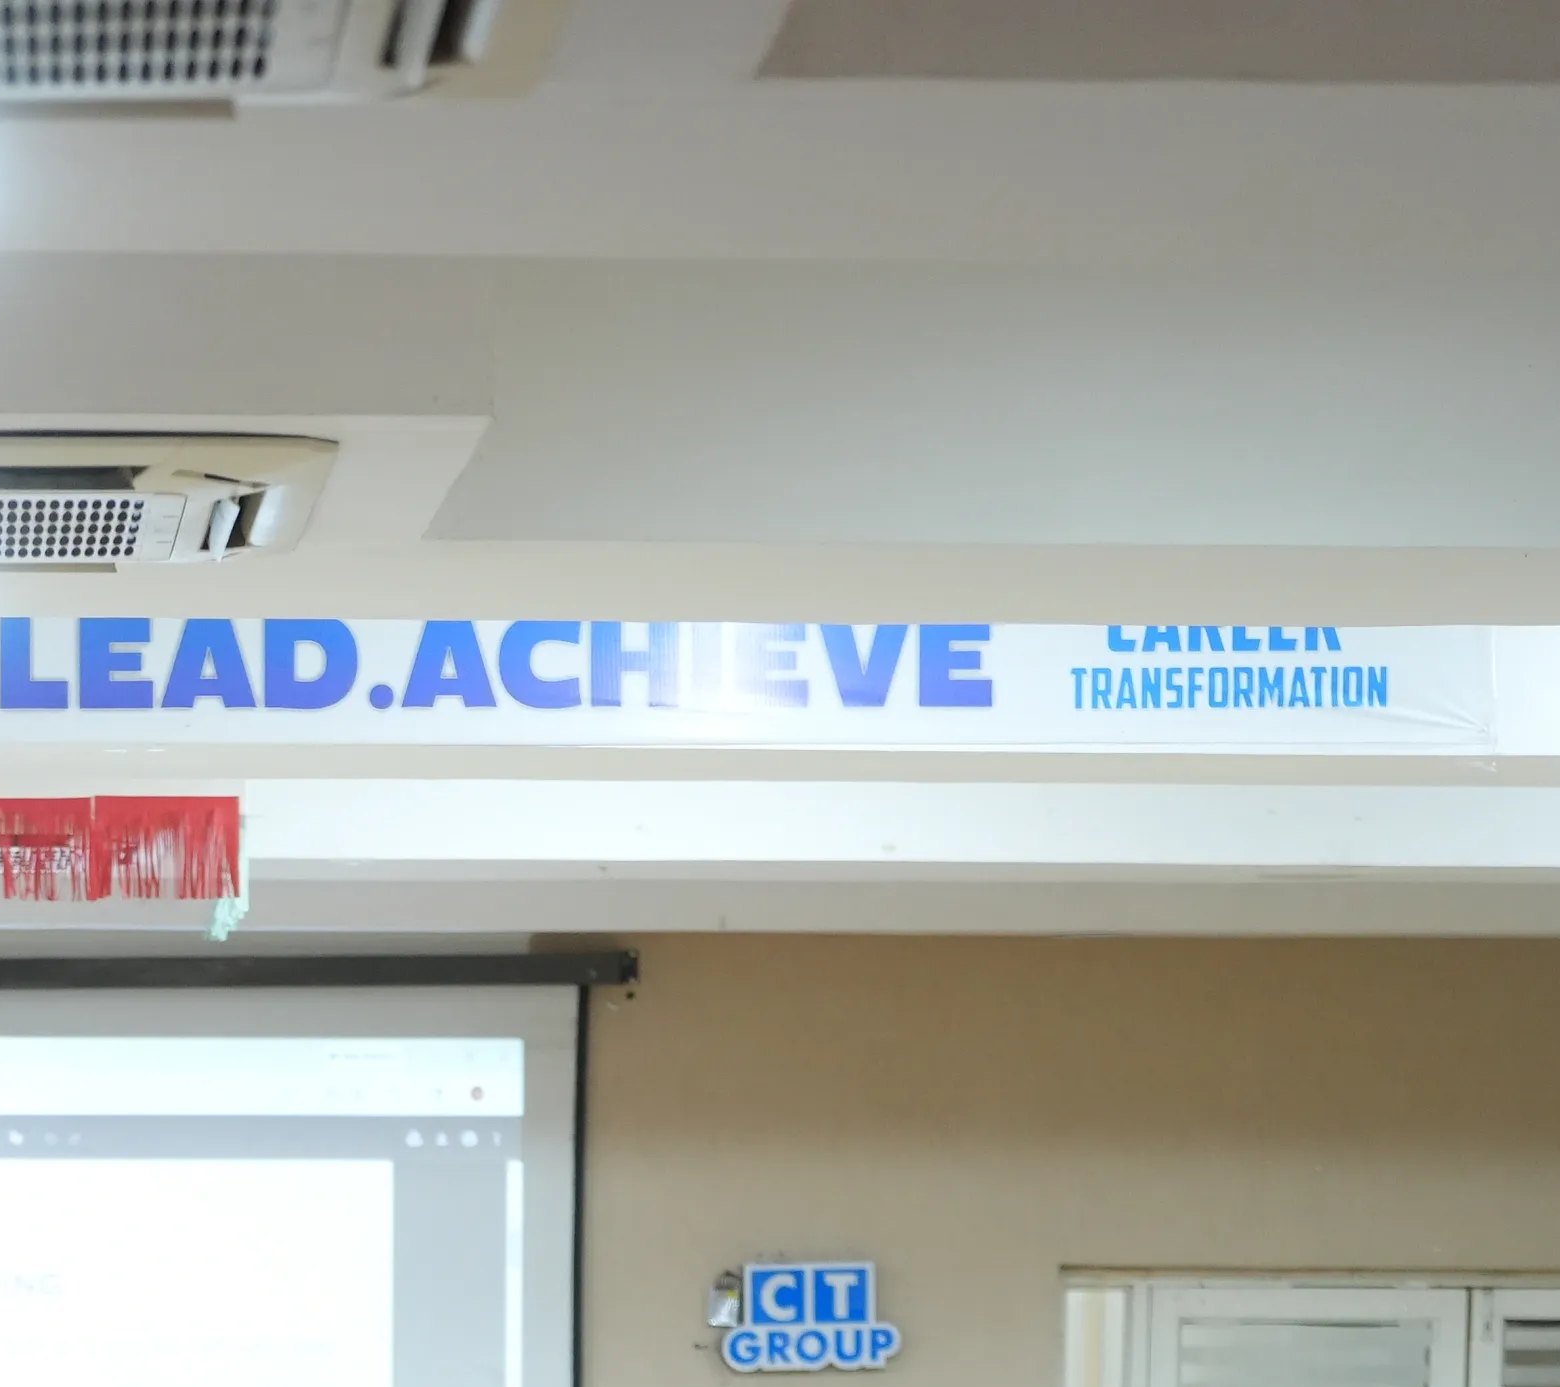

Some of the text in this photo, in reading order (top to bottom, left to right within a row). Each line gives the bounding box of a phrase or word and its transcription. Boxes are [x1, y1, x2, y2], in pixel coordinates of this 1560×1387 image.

[1070, 666, 1388, 710] TRANSFORMATION
[759, 1272, 861, 1322] CT
[729, 1328, 896, 1364] GROUP
